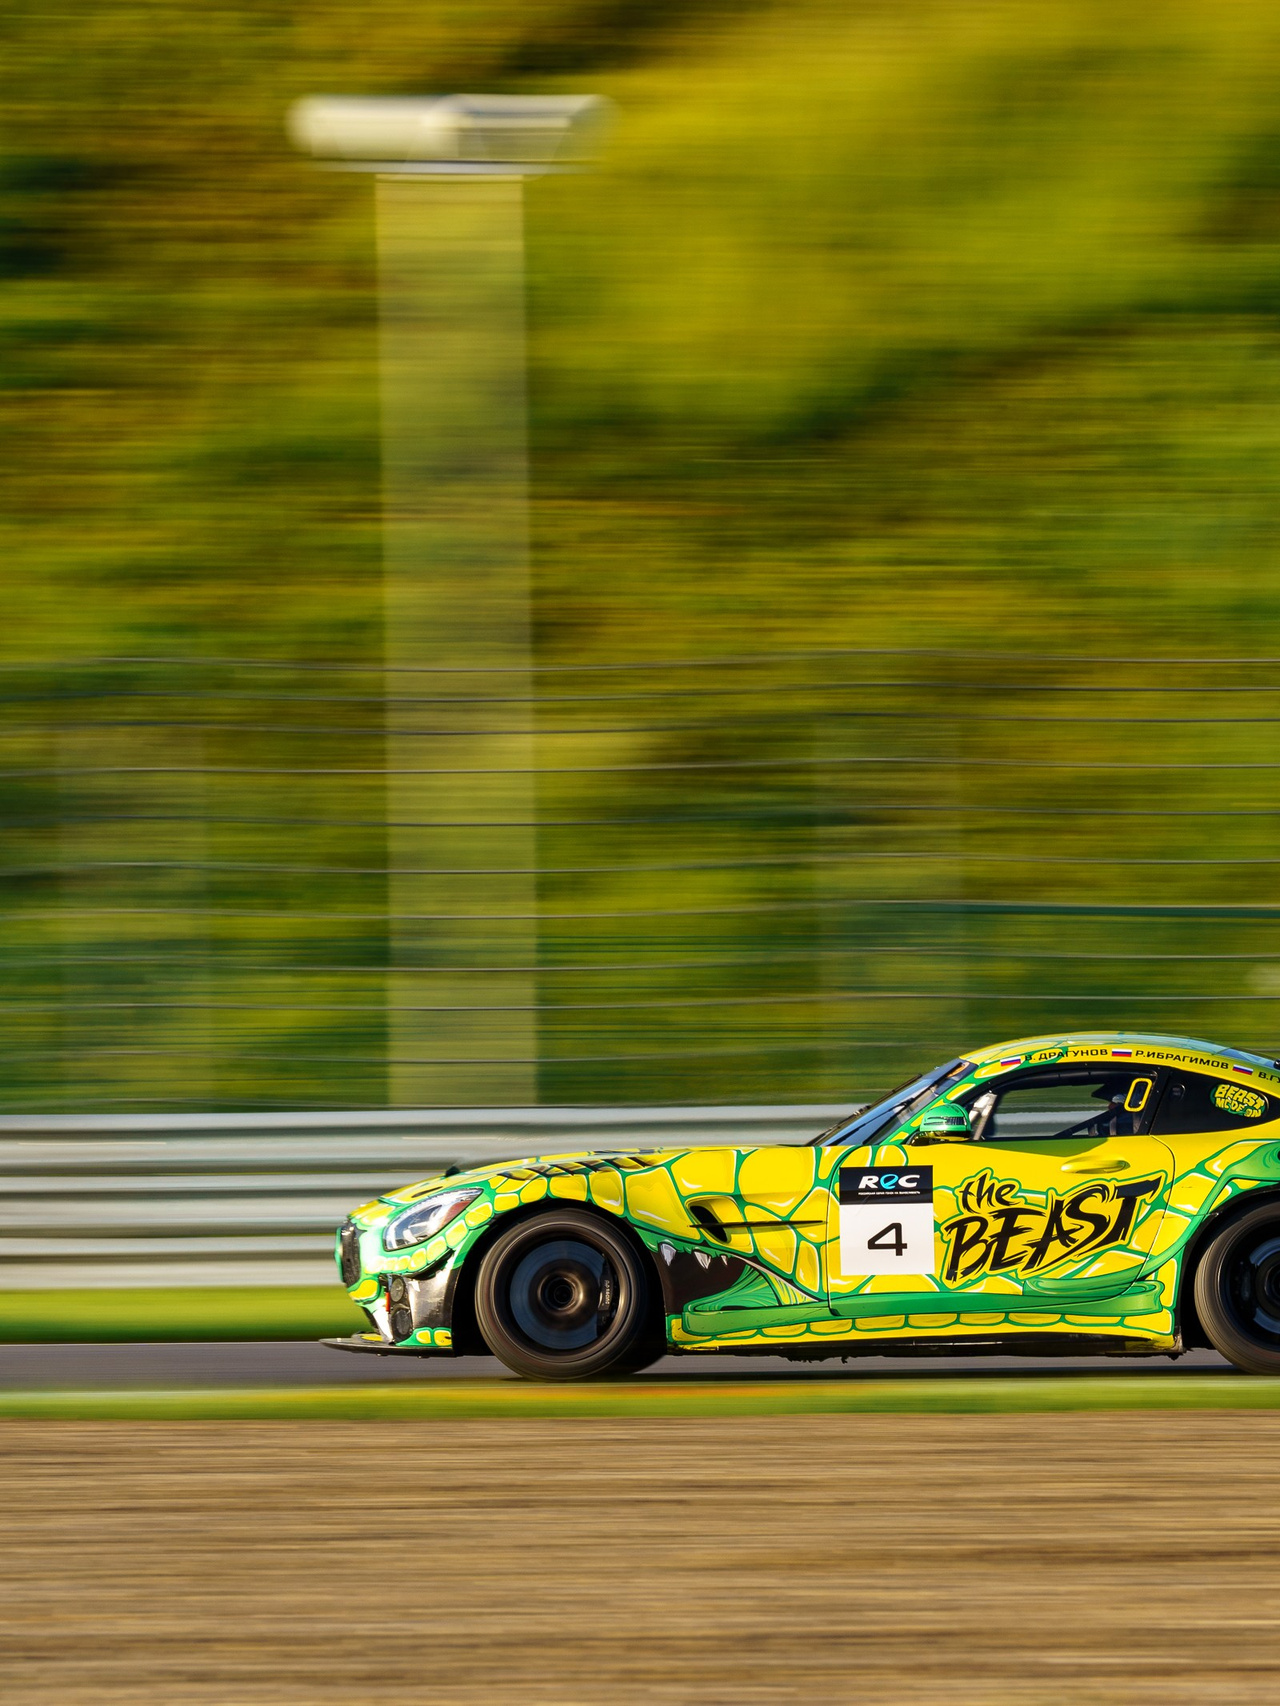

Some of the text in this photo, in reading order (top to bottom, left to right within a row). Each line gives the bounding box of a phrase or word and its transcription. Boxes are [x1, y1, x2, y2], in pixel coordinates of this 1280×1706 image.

[1038, 1049, 1108, 1061] ДРАГУНОВ
[1135, 1050, 1229, 1069] Р.ИБРАГИМОВ
[1215, 1084, 1265, 1109] BEAST
[1216, 1098, 1245, 1112] MODE
[1244, 1108, 1262, 1118] ON
[960, 1172, 1022, 1214] the
[867, 1222, 908, 1257] 4
[944, 1175, 1163, 1284] BEAST
